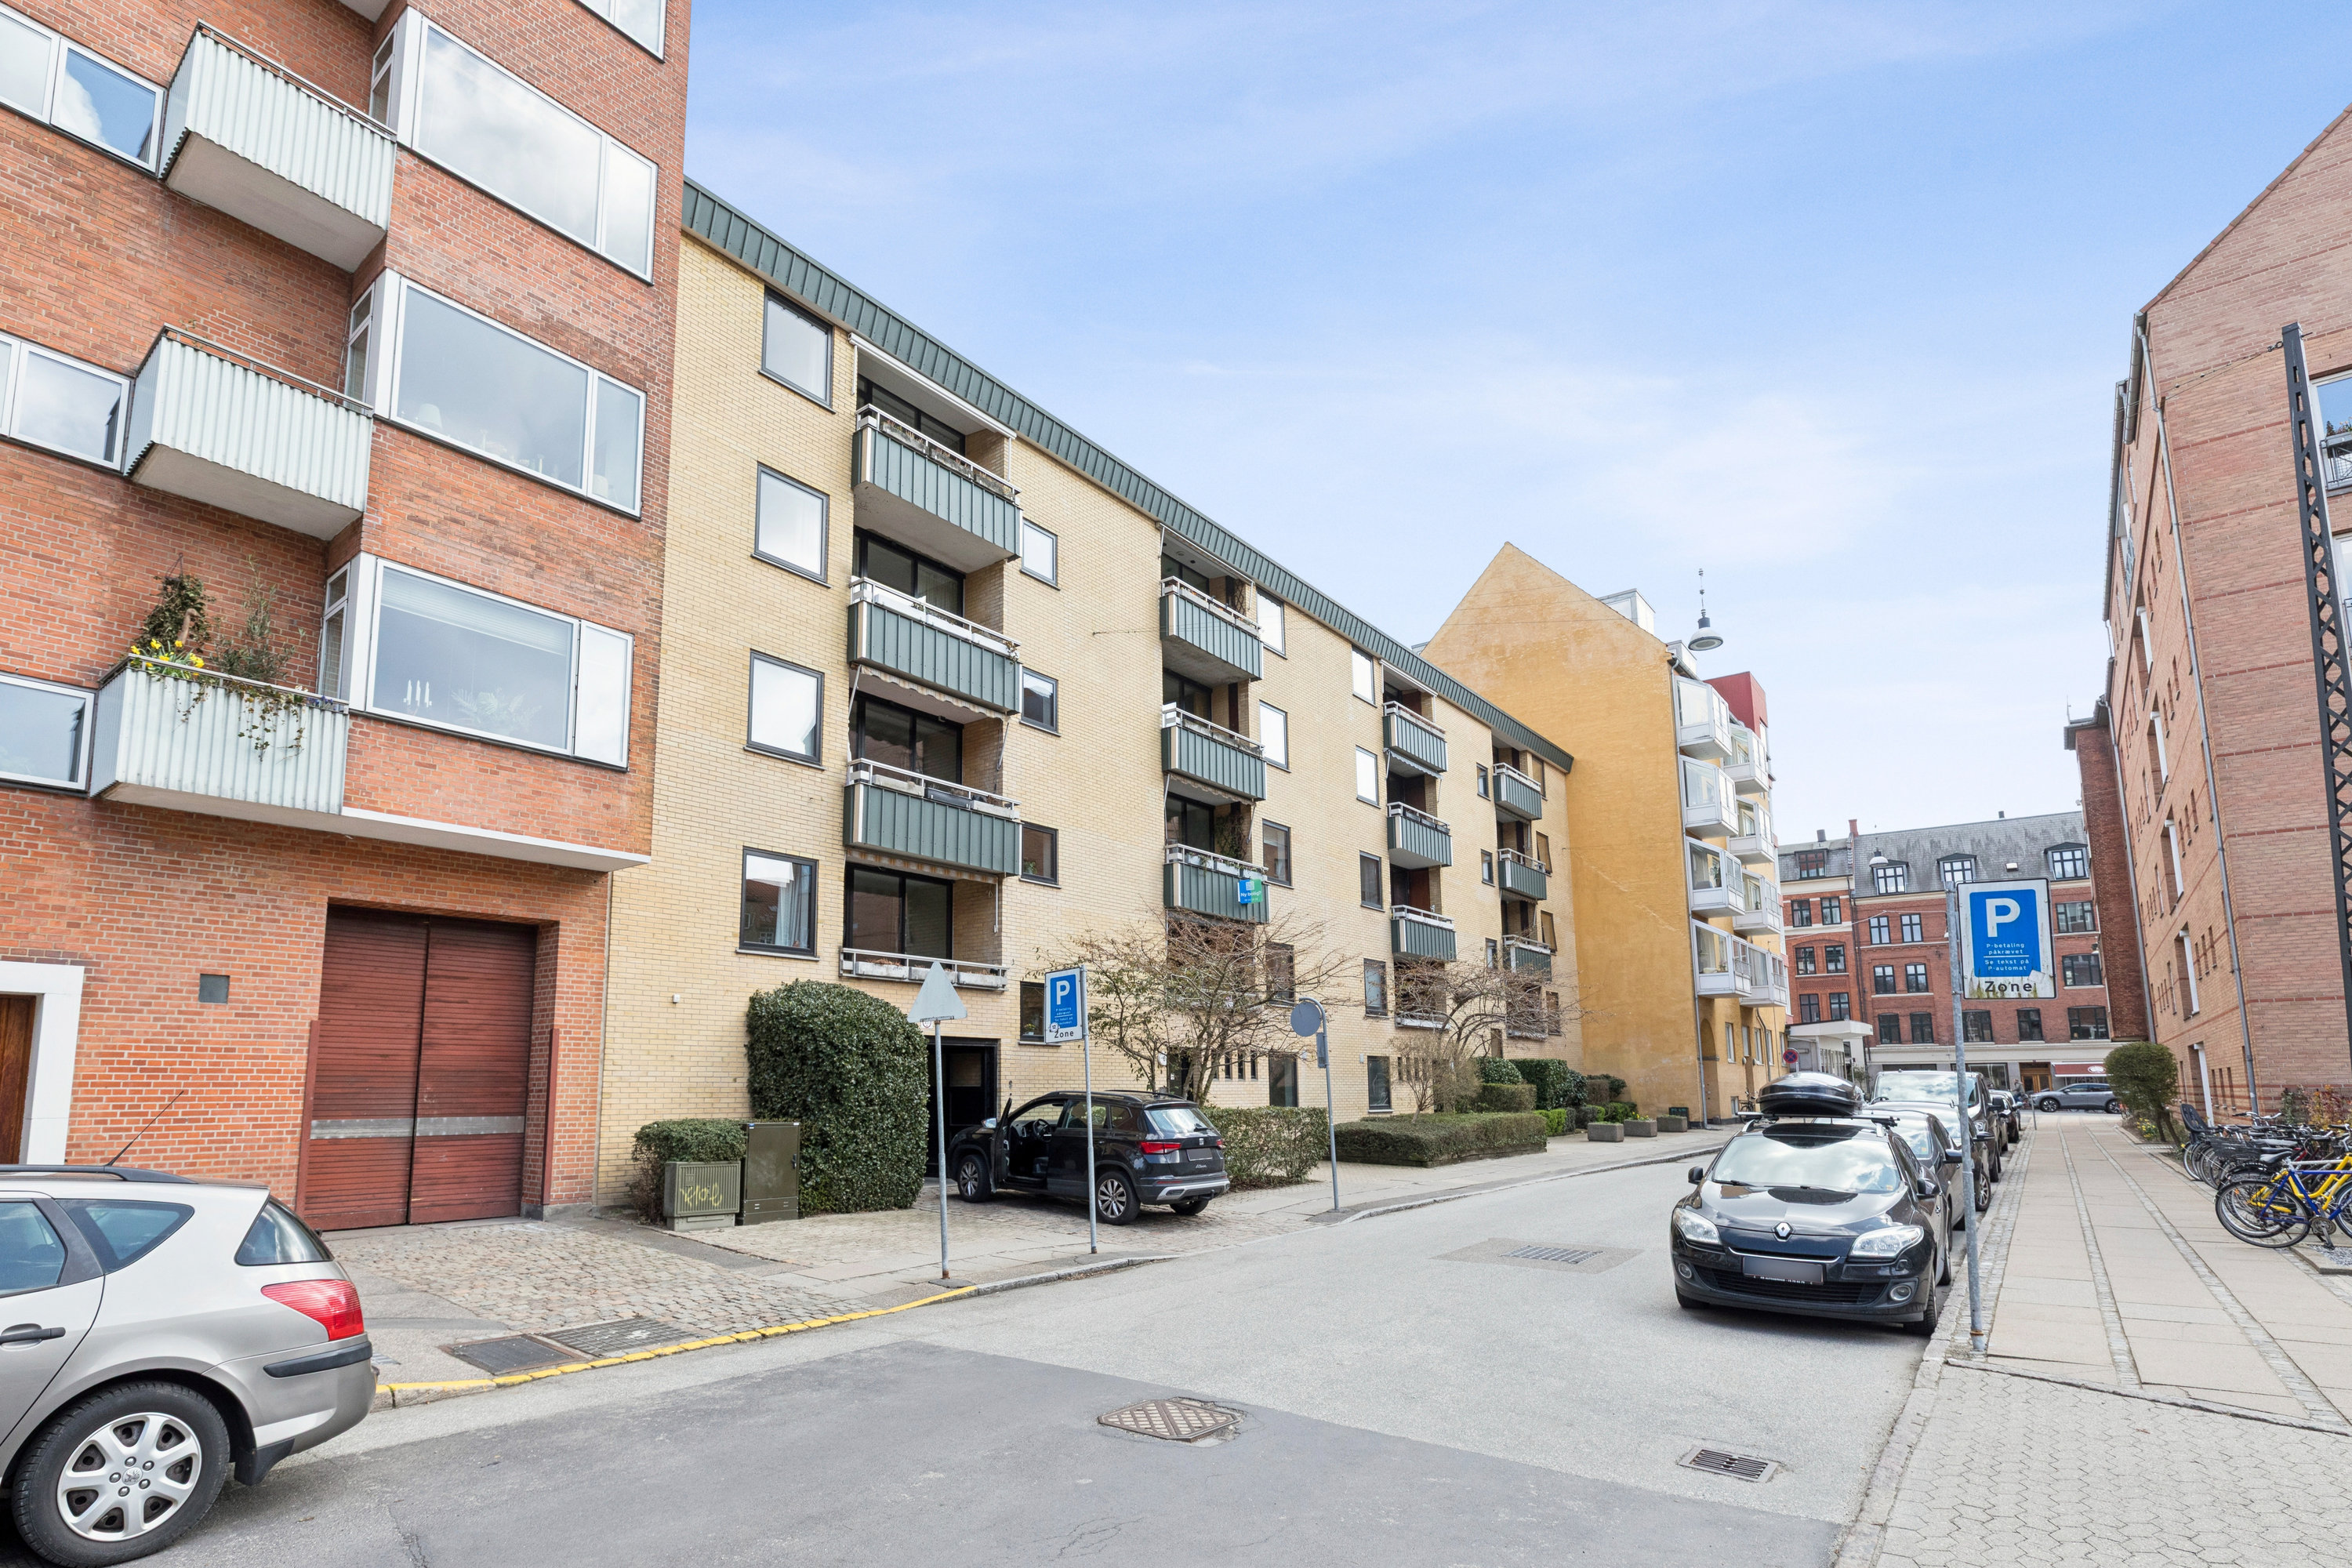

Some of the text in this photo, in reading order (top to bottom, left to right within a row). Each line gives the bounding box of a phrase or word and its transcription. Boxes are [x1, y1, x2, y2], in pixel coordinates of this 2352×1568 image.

[1986, 898, 2020, 937] P
[1056, 980, 1070, 1005] P
[1984, 981, 2033, 993] Zone
